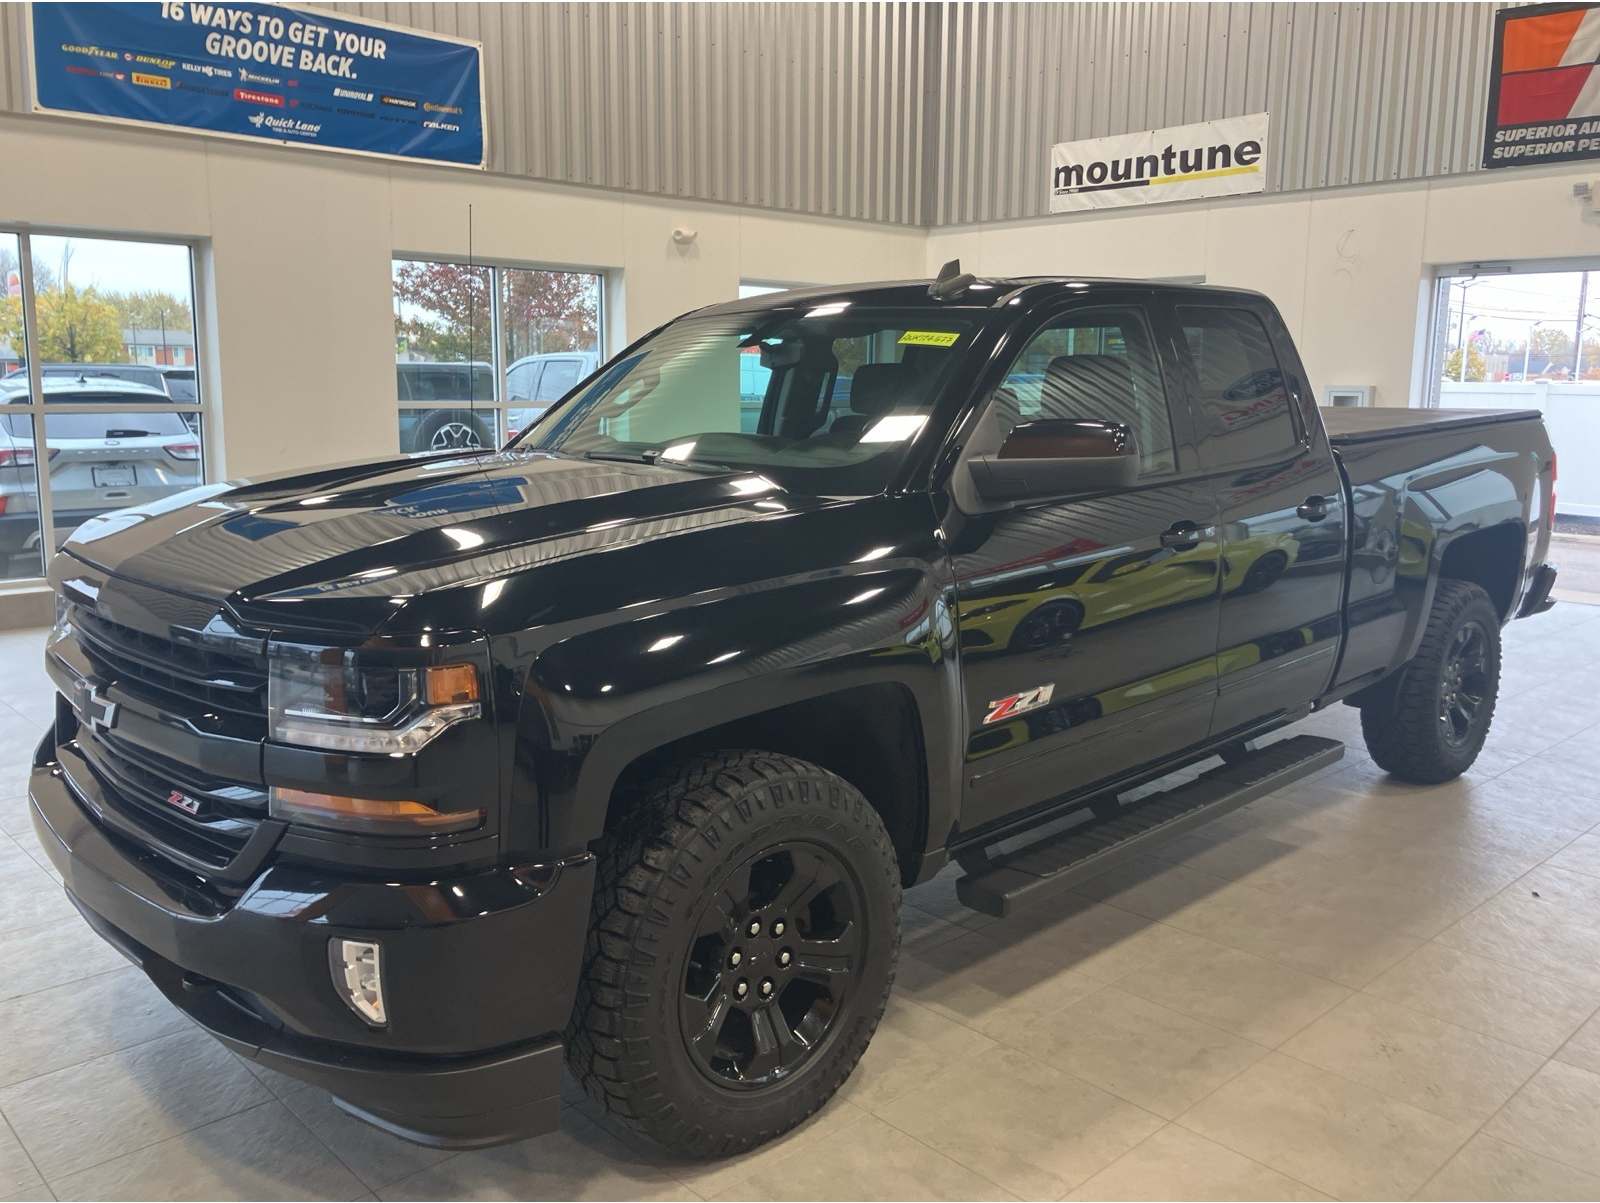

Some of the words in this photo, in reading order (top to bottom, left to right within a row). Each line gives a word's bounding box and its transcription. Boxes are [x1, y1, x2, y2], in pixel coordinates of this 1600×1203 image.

[160, 2, 185, 21] 16
[189, 3, 253, 34] WAYS
[257, 15, 285, 38] TO
[288, 22, 329, 48] GET
[333, 30, 387, 60] YOUR
[61, 43, 118, 59] GOODYEAR
[205, 32, 294, 68] GROOVE
[299, 49, 358, 80] BACK.
[135, 55, 176, 68] DUNLOP
[182, 62, 203, 73] KELLY
[265, 116, 295, 129] Quick
[295, 120, 321, 132] Lane
[423, 121, 460, 132] FALKEN
[1494, 124, 1577, 143] SUPERIOR
[1578, 121, 1600, 135] AI
[1493, 141, 1575, 159] SUPERIOR
[1054, 140, 1261, 188] mountune
[983, 684, 1055, 725] Z71
[167, 790, 201, 815] Z71
